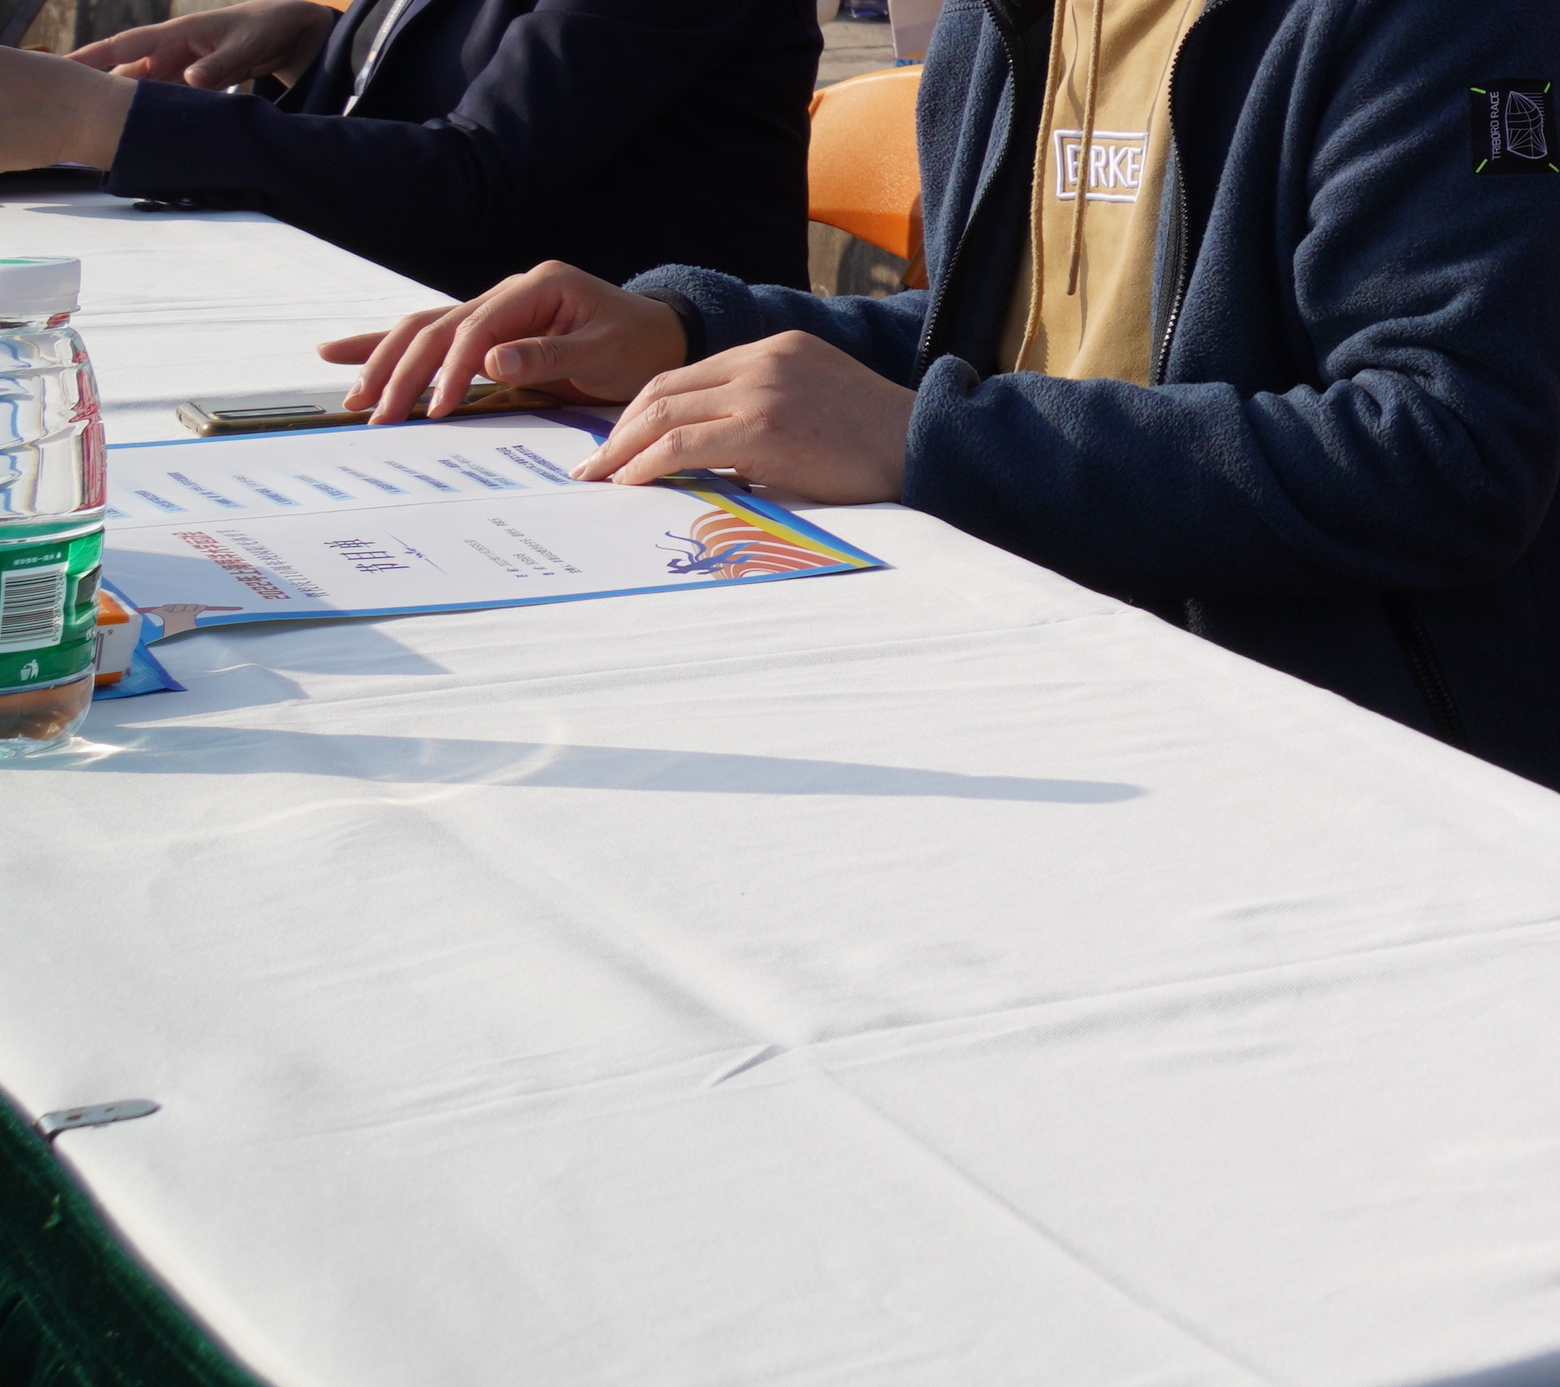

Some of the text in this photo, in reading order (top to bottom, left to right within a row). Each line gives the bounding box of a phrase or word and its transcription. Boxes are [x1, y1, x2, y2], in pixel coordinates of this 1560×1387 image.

[1490, 91, 1502, 161] TRIBORD RACE
[1067, 144, 1142, 189] ERKE
